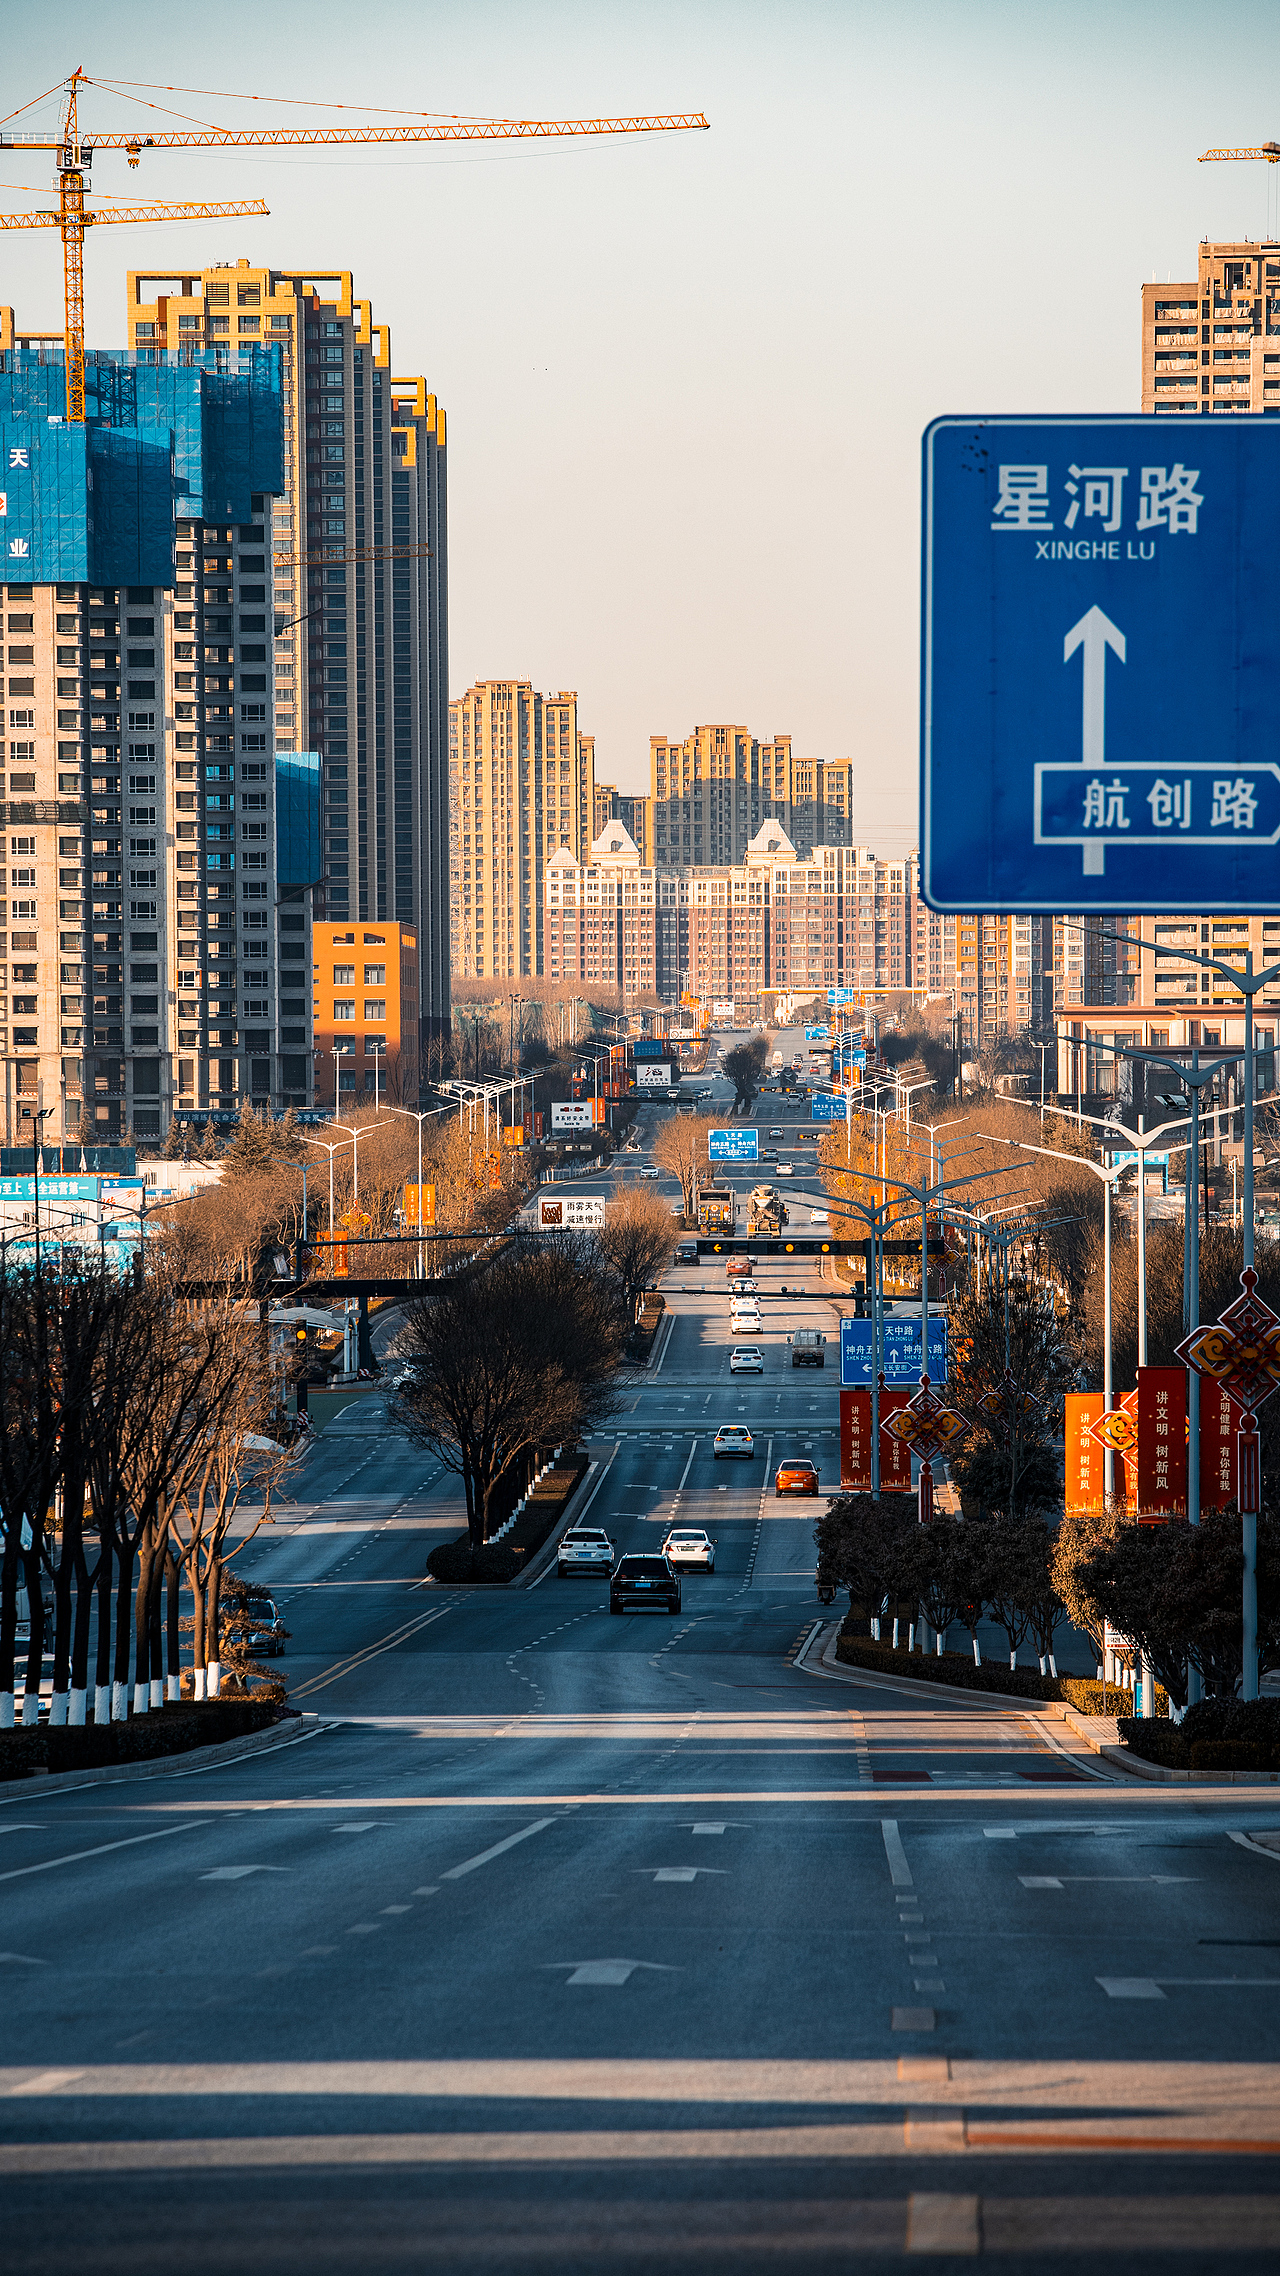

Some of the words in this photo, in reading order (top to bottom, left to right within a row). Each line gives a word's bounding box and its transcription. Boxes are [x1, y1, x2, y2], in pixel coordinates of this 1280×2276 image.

[9, 448, 29, 467] 天
[991, 463, 1204, 534] 星河路
[9, 538, 29, 557] 业
[1035, 541, 1120, 560] XINGHE
[1127, 541, 1156, 560] LU
[1083, 778, 1257, 829] 航创路
[28, 1181, 89, 1195] 安全运营第一
[567, 1202, 602, 1211] 雨雾天气
[567, 1215, 602, 1224] 减速慢行
[876, 1325, 914, 1336] 天中路
[846, 1344, 885, 1354] 神舟五
[851, 1405, 860, 1435] 讲文明
[1156, 1391, 1169, 1436] 讲文明
[1220, 1391, 1231, 1435] 文明健康
[1080, 1413, 1090, 1448] 讲文明
[851, 1440, 861, 1469] 树新风
[892, 1441, 900, 1470] 有你有我
[1156, 1445, 1169, 1490] 树新风
[1220, 1446, 1231, 1491] 有你有我
[1079, 1455, 1090, 1490] 树新风
